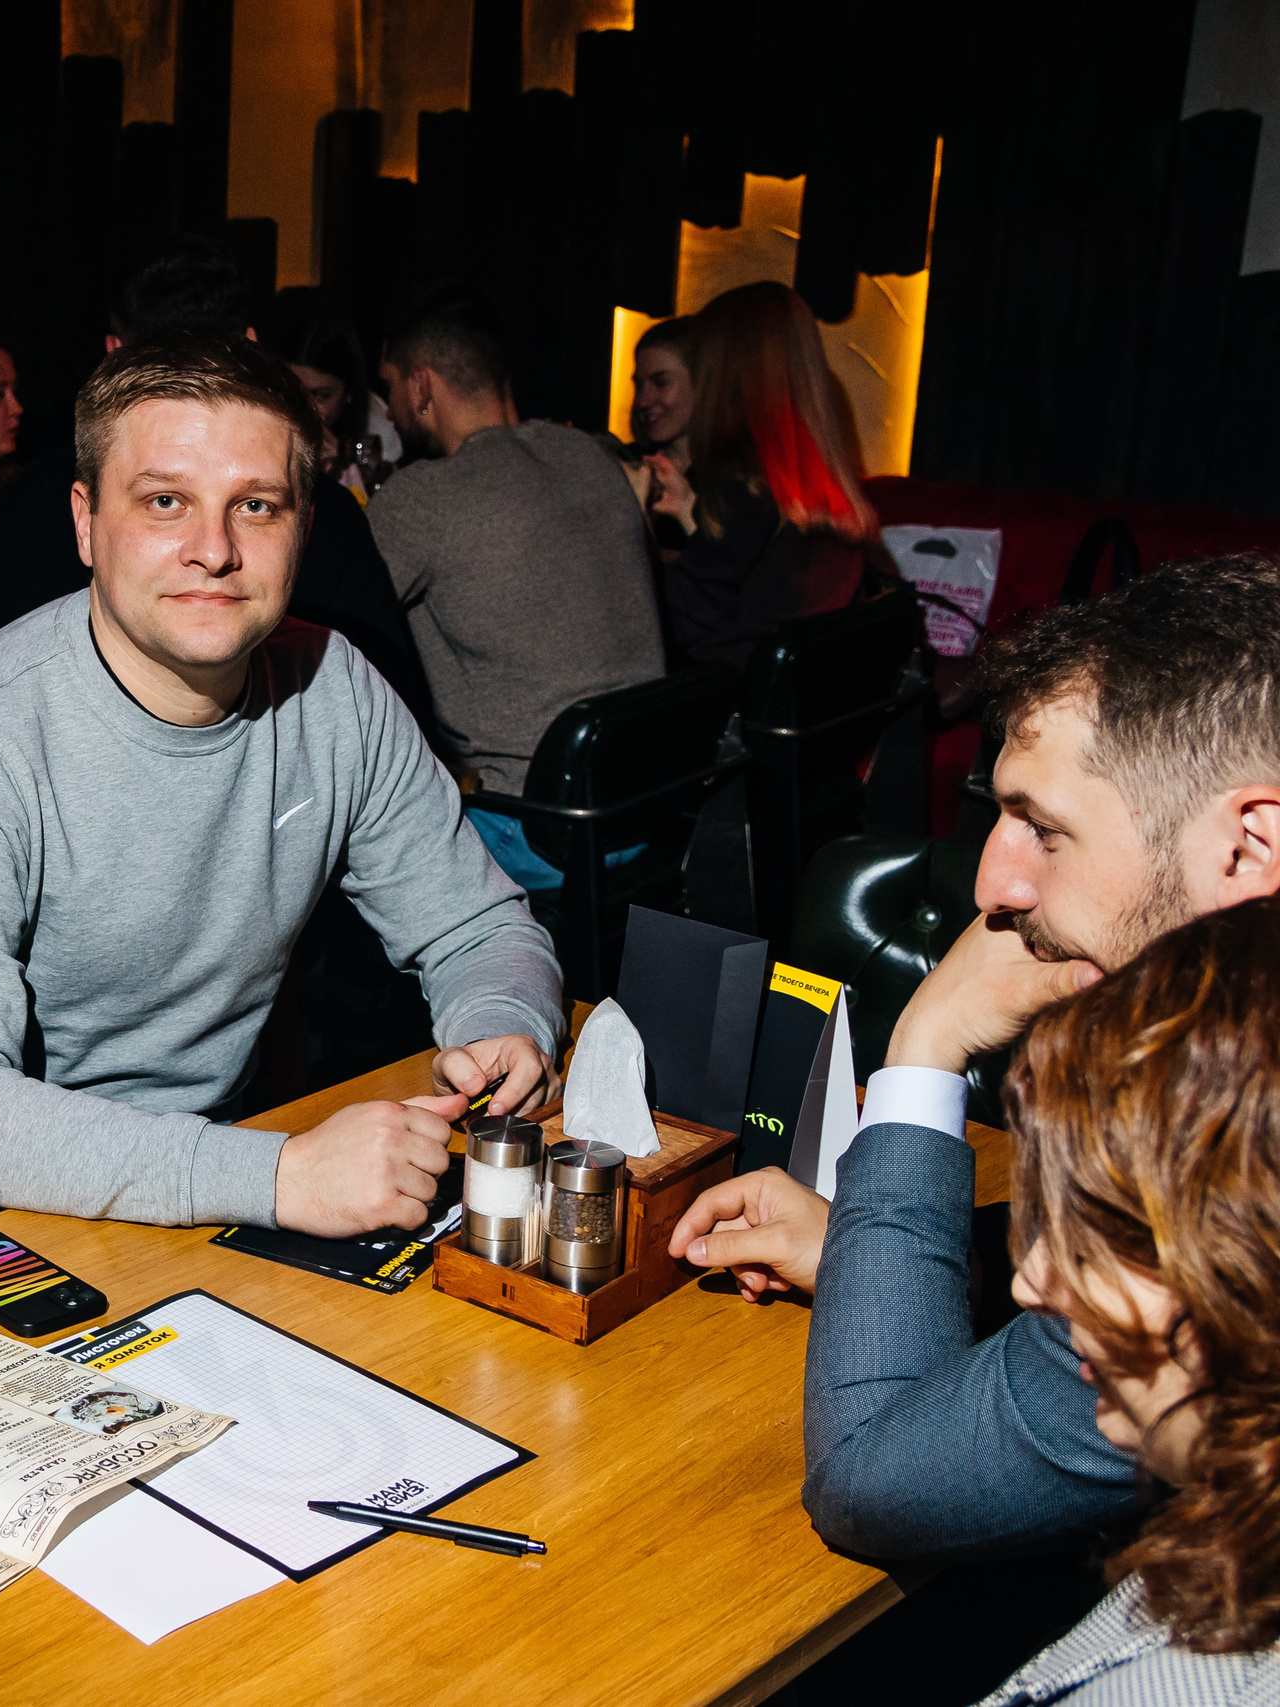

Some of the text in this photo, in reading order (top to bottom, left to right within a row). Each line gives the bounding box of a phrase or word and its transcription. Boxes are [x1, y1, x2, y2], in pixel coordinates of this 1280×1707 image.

[779, 974, 804, 988] ТВОЕГО
[805, 983, 830, 997] ВЕЧЕРА
[71, 1325, 147, 1363] Листочек
[105, 1331, 173, 1364] заметок
[63, 1438, 160, 1484] ОСОБНЯК
[70, 1441, 124, 1467] ГАСТРОПАБ
[16, 1456, 67, 1482] САЛАТЫ
[365, 1478, 418, 1505] МАМА
[377, 1481, 430, 1510] КВИЗ!
